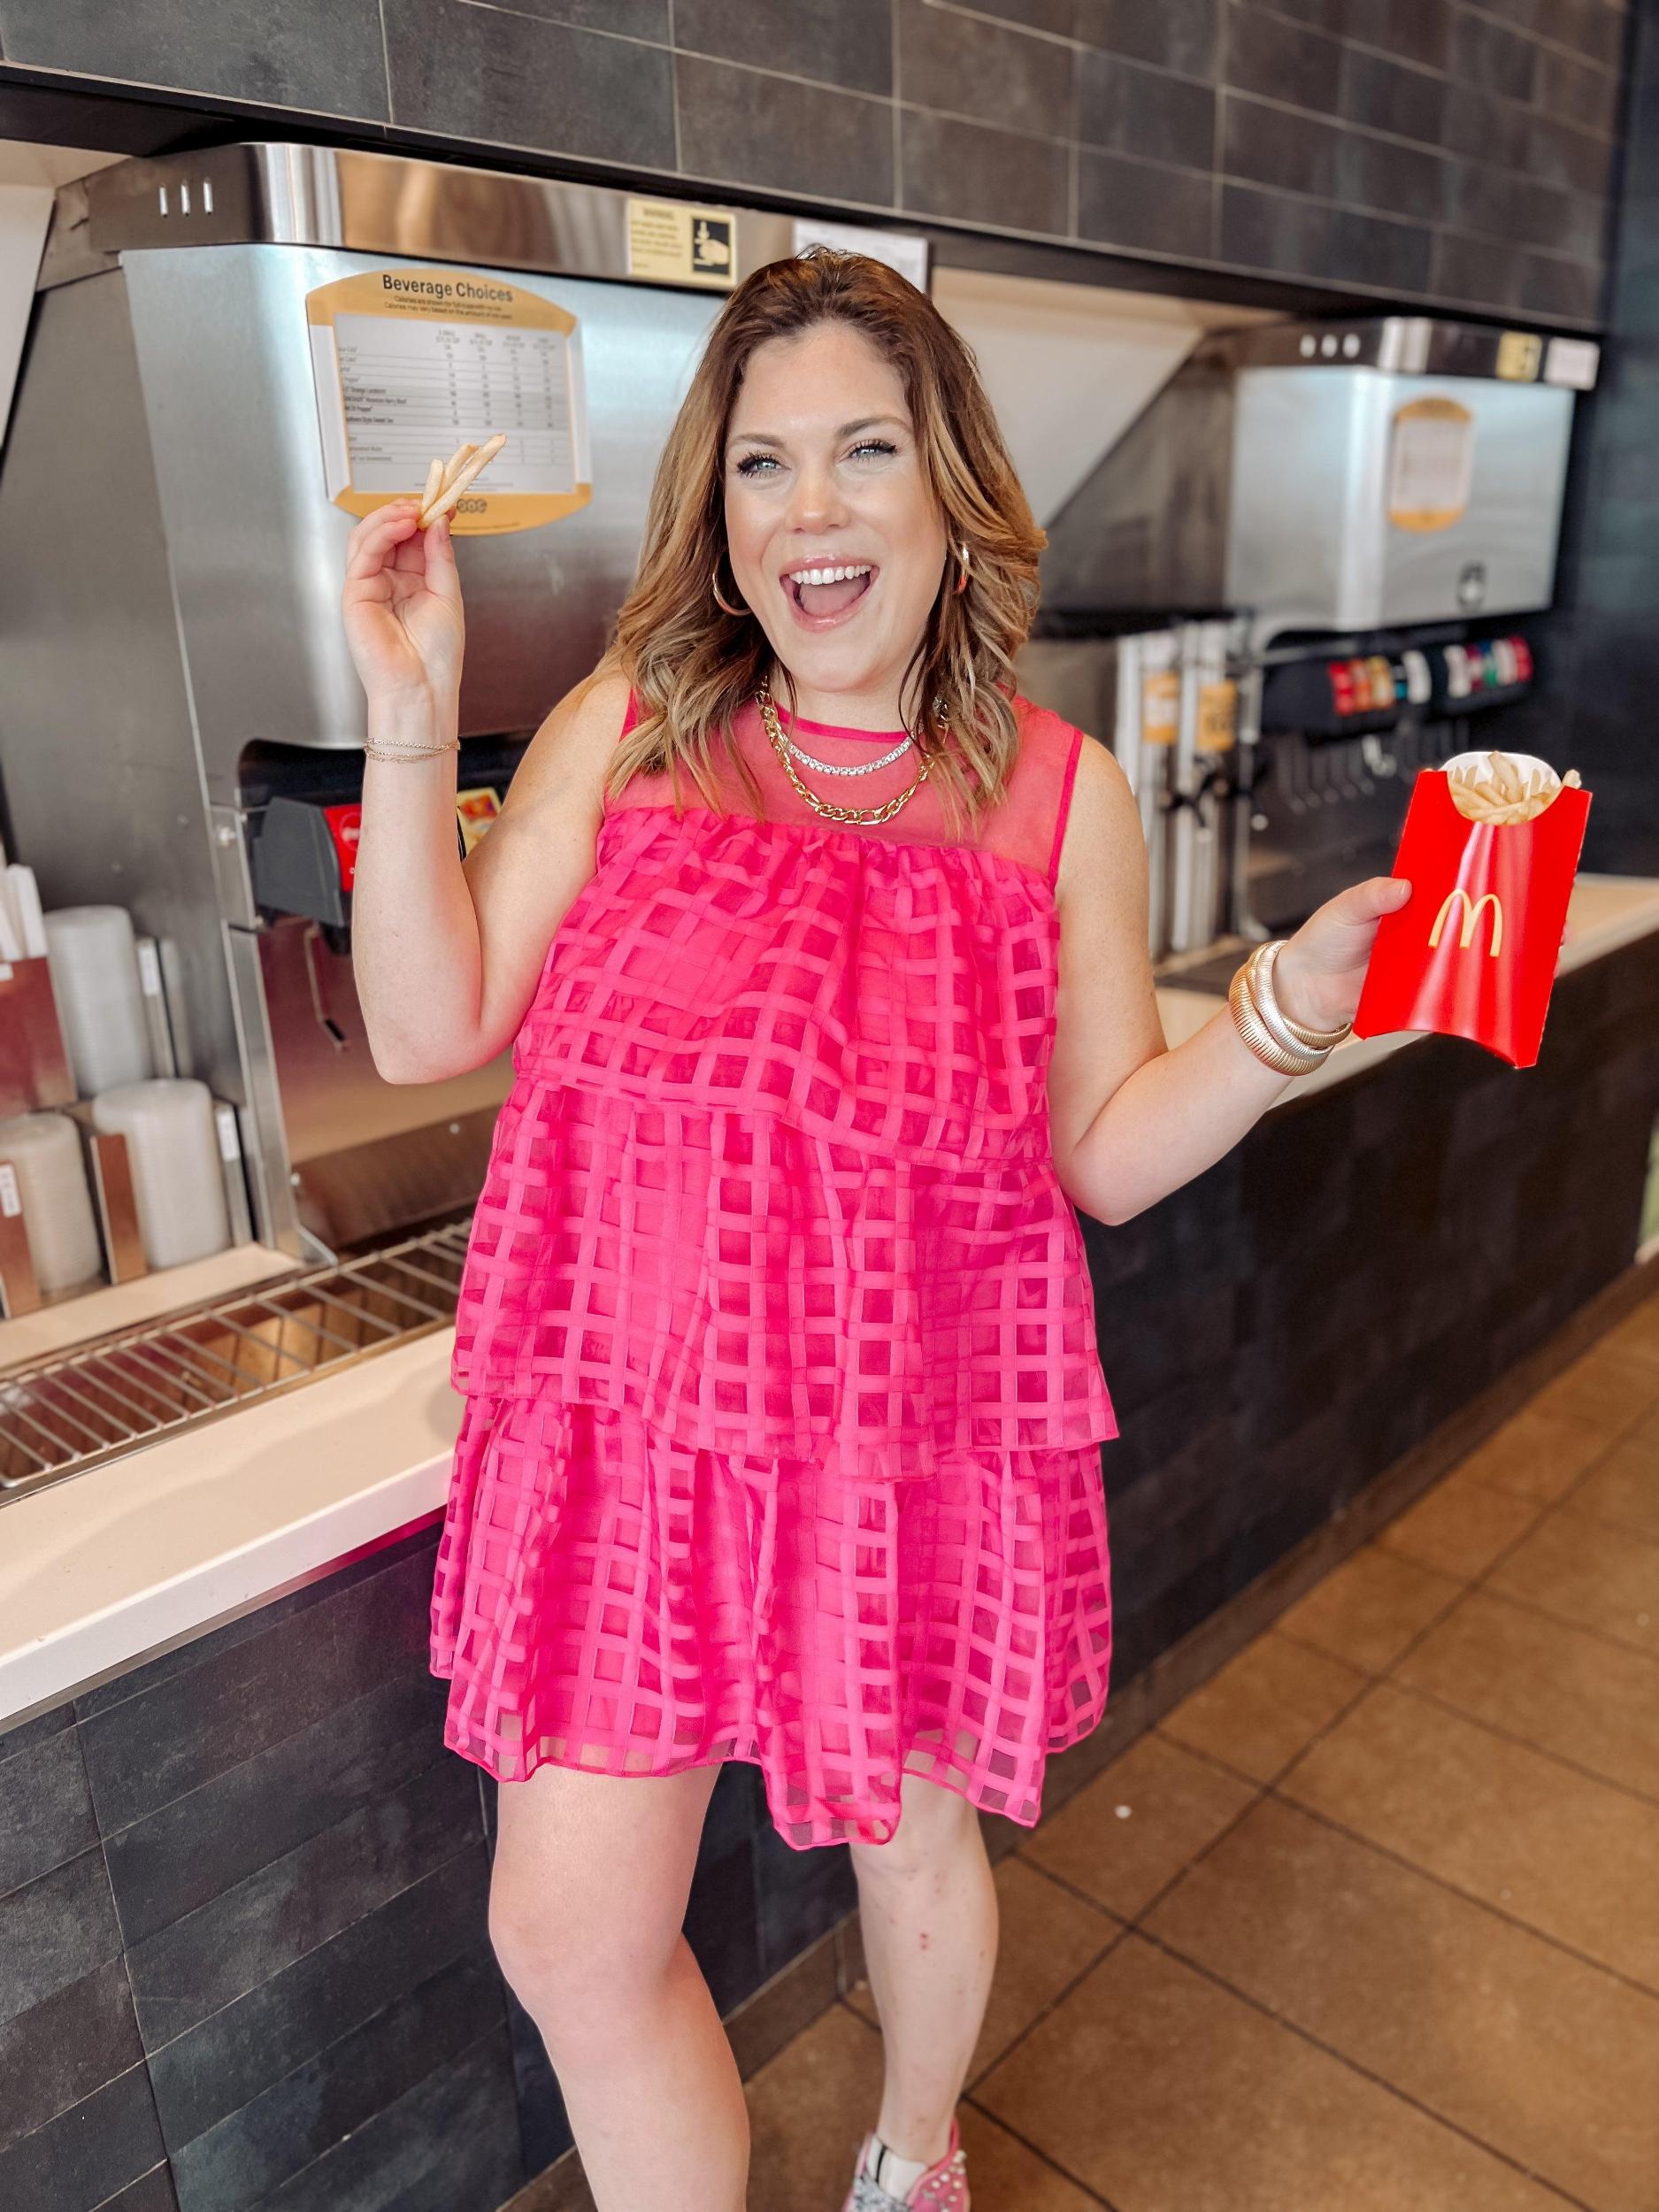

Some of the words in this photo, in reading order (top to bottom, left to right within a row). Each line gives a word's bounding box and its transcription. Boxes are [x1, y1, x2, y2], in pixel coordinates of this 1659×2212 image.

[382, 274, 452, 299] Beverage
[457, 282, 513, 302] Choices
[1428, 888, 1502, 956] M
